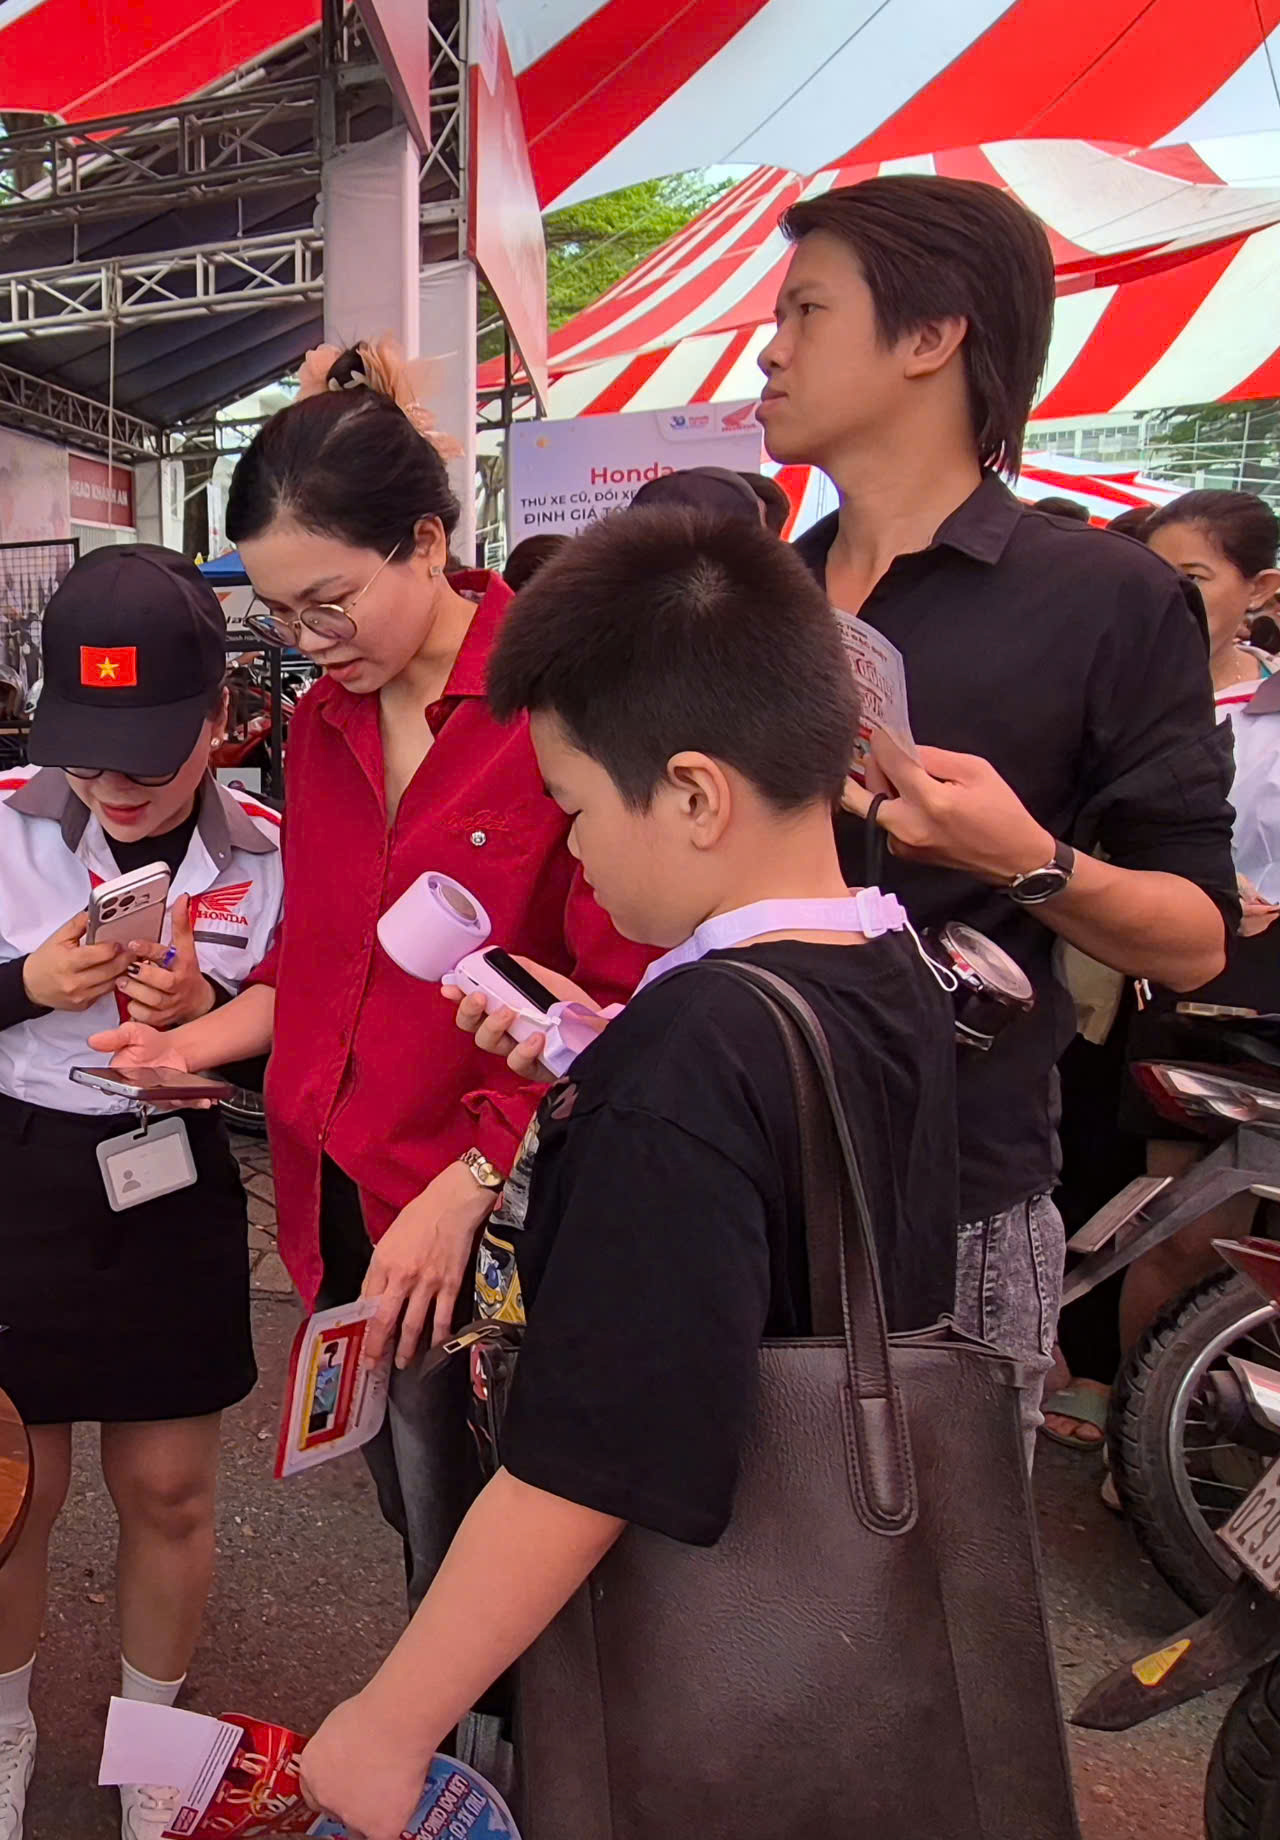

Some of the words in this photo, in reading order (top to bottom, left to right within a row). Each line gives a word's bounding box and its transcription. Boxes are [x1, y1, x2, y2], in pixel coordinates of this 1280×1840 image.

[521, 496, 547, 509] THU
[550, 495, 567, 506] XE
[523, 510, 566, 527] ĐỊNH
[570, 506, 598, 521] GIÁ
[196, 910, 249, 926] HONDA
